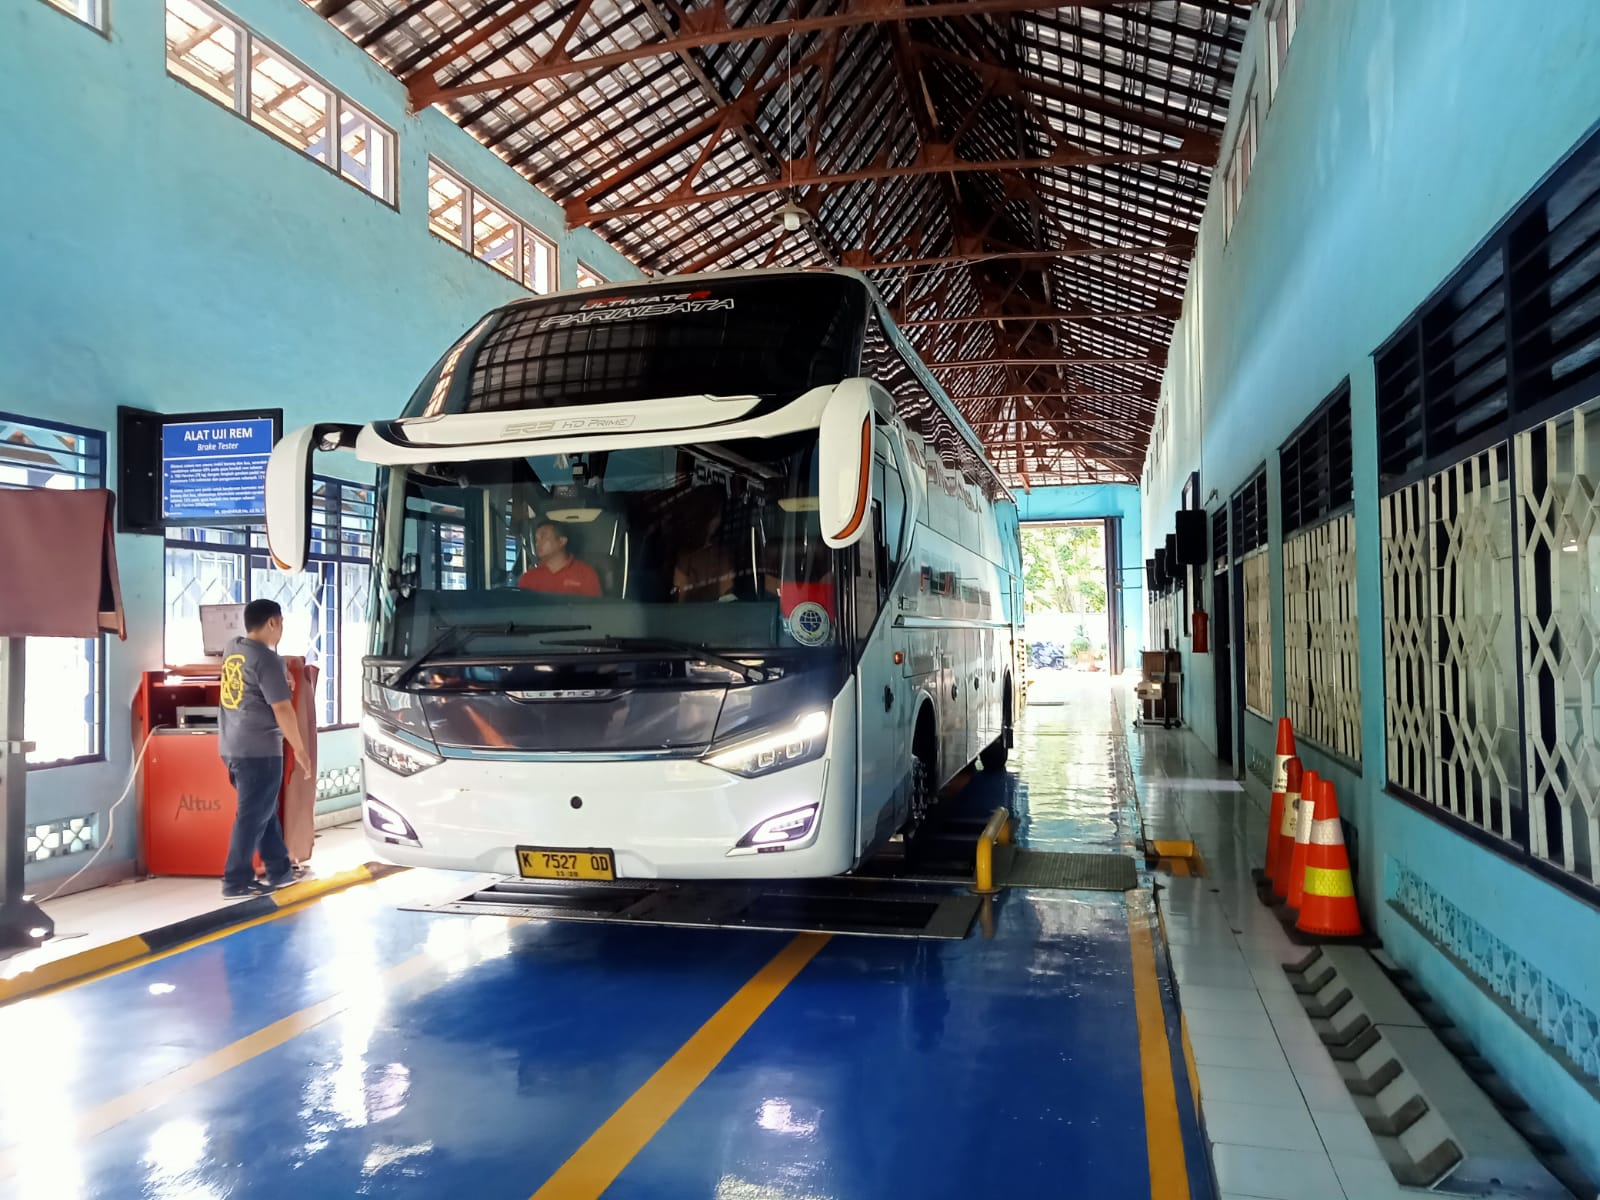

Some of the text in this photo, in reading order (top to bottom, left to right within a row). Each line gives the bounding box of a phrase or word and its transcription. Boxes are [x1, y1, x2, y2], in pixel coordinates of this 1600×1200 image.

[580, 294, 690, 310] ULTIMATE
[540, 298, 735, 328] PARIWISATA
[184, 427, 253, 441] ALAT UJI REM
[197, 441, 239, 451] Brake Tester
[174, 794, 221, 821] Altus
[521, 852, 609, 871] K 7527 OD
